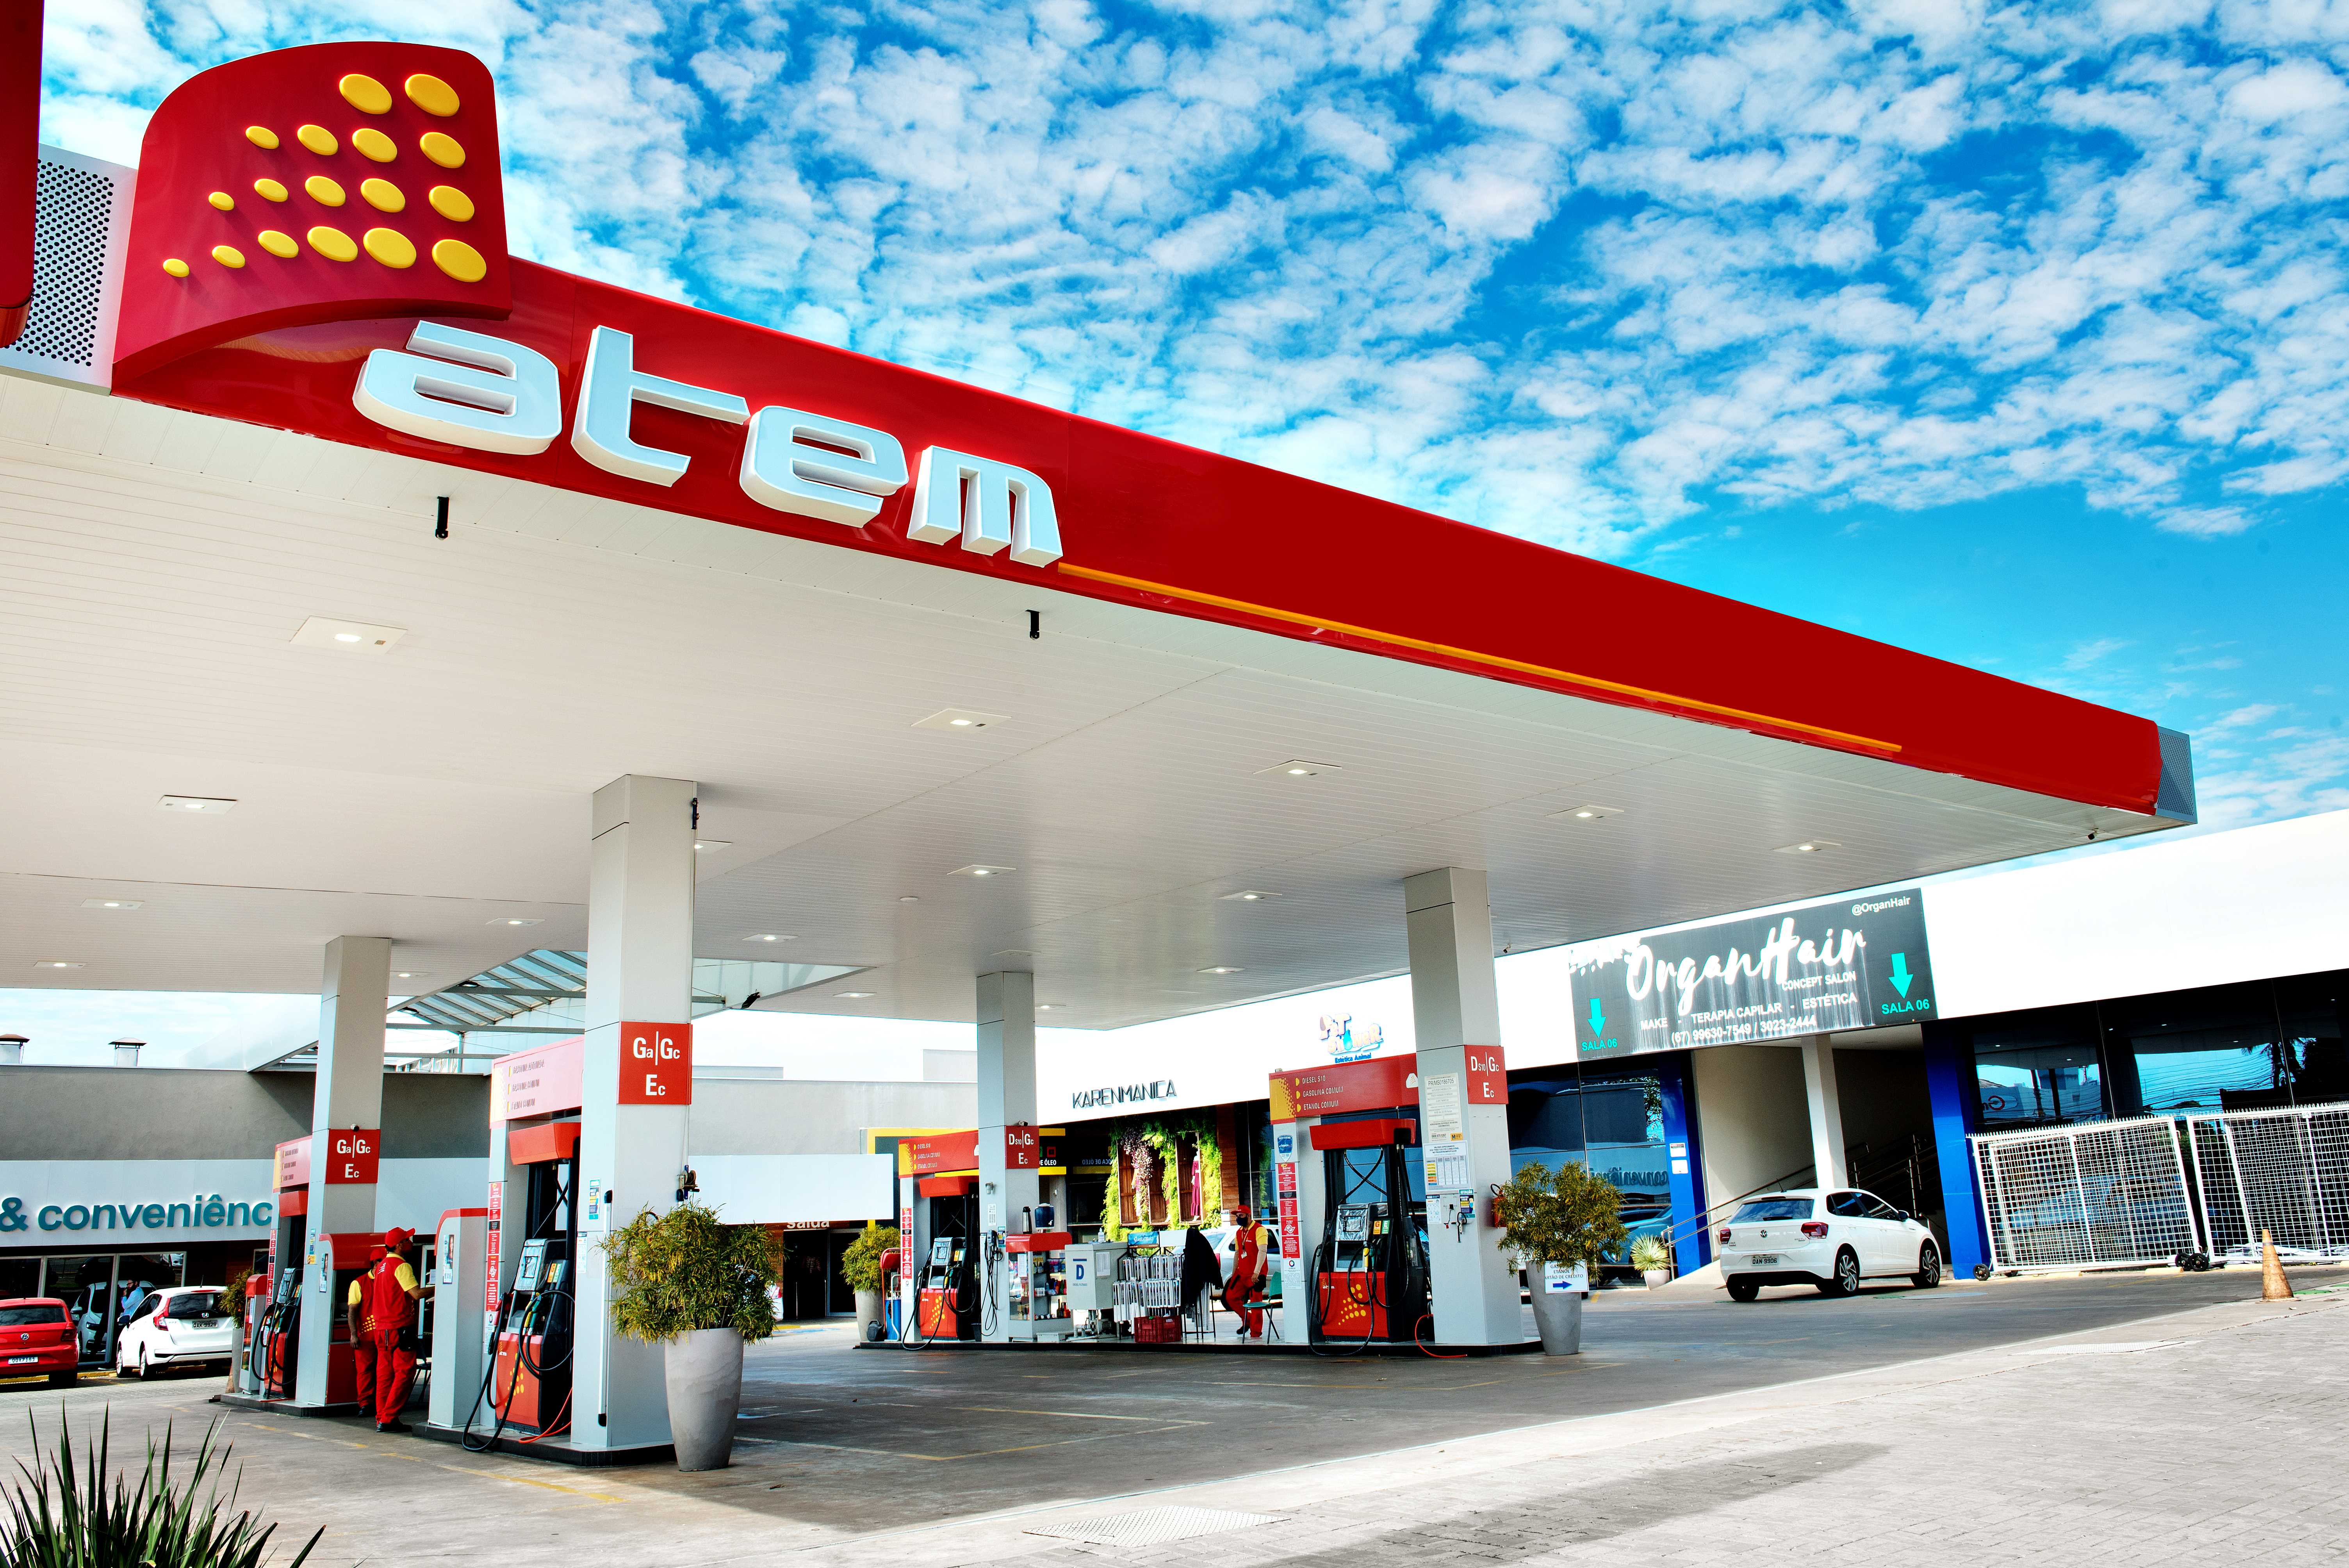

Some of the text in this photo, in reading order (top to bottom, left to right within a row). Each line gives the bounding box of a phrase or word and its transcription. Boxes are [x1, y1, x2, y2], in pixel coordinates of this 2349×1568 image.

[352, 320, 1063, 567] atem
[1852, 896, 1911, 916] @OrganHair
[1781, 971, 1856, 991] CONCEPT SALON
[1640, 1017, 1668, 1030] MAKE
[1691, 1009, 1734, 1024] TERAPIA
[1736, 1002, 1782, 1017] CAPILAR
[1802, 993, 1858, 1009] ESTÉTICA
[1882, 999, 1930, 1014] SALA 06
[1671, 1030, 1690, 1044] (67)
[1693, 1023, 1751, 1040] 99630-7549
[1760, 1015, 1816, 1033] 3023-2444
[1582, 1038, 1618, 1051] SALA 06
[646, 1074, 666, 1096] Ec
[1303, 1086, 1344, 1097] GASOLINA COMUM
[1483, 1082, 1494, 1098] Ec
[1018, 1153, 1028, 1164] Ec
[345, 1164, 360, 1178] Ec
[0, 1197, 29, 1232] &
[1076, 1264, 1084, 1280] D
